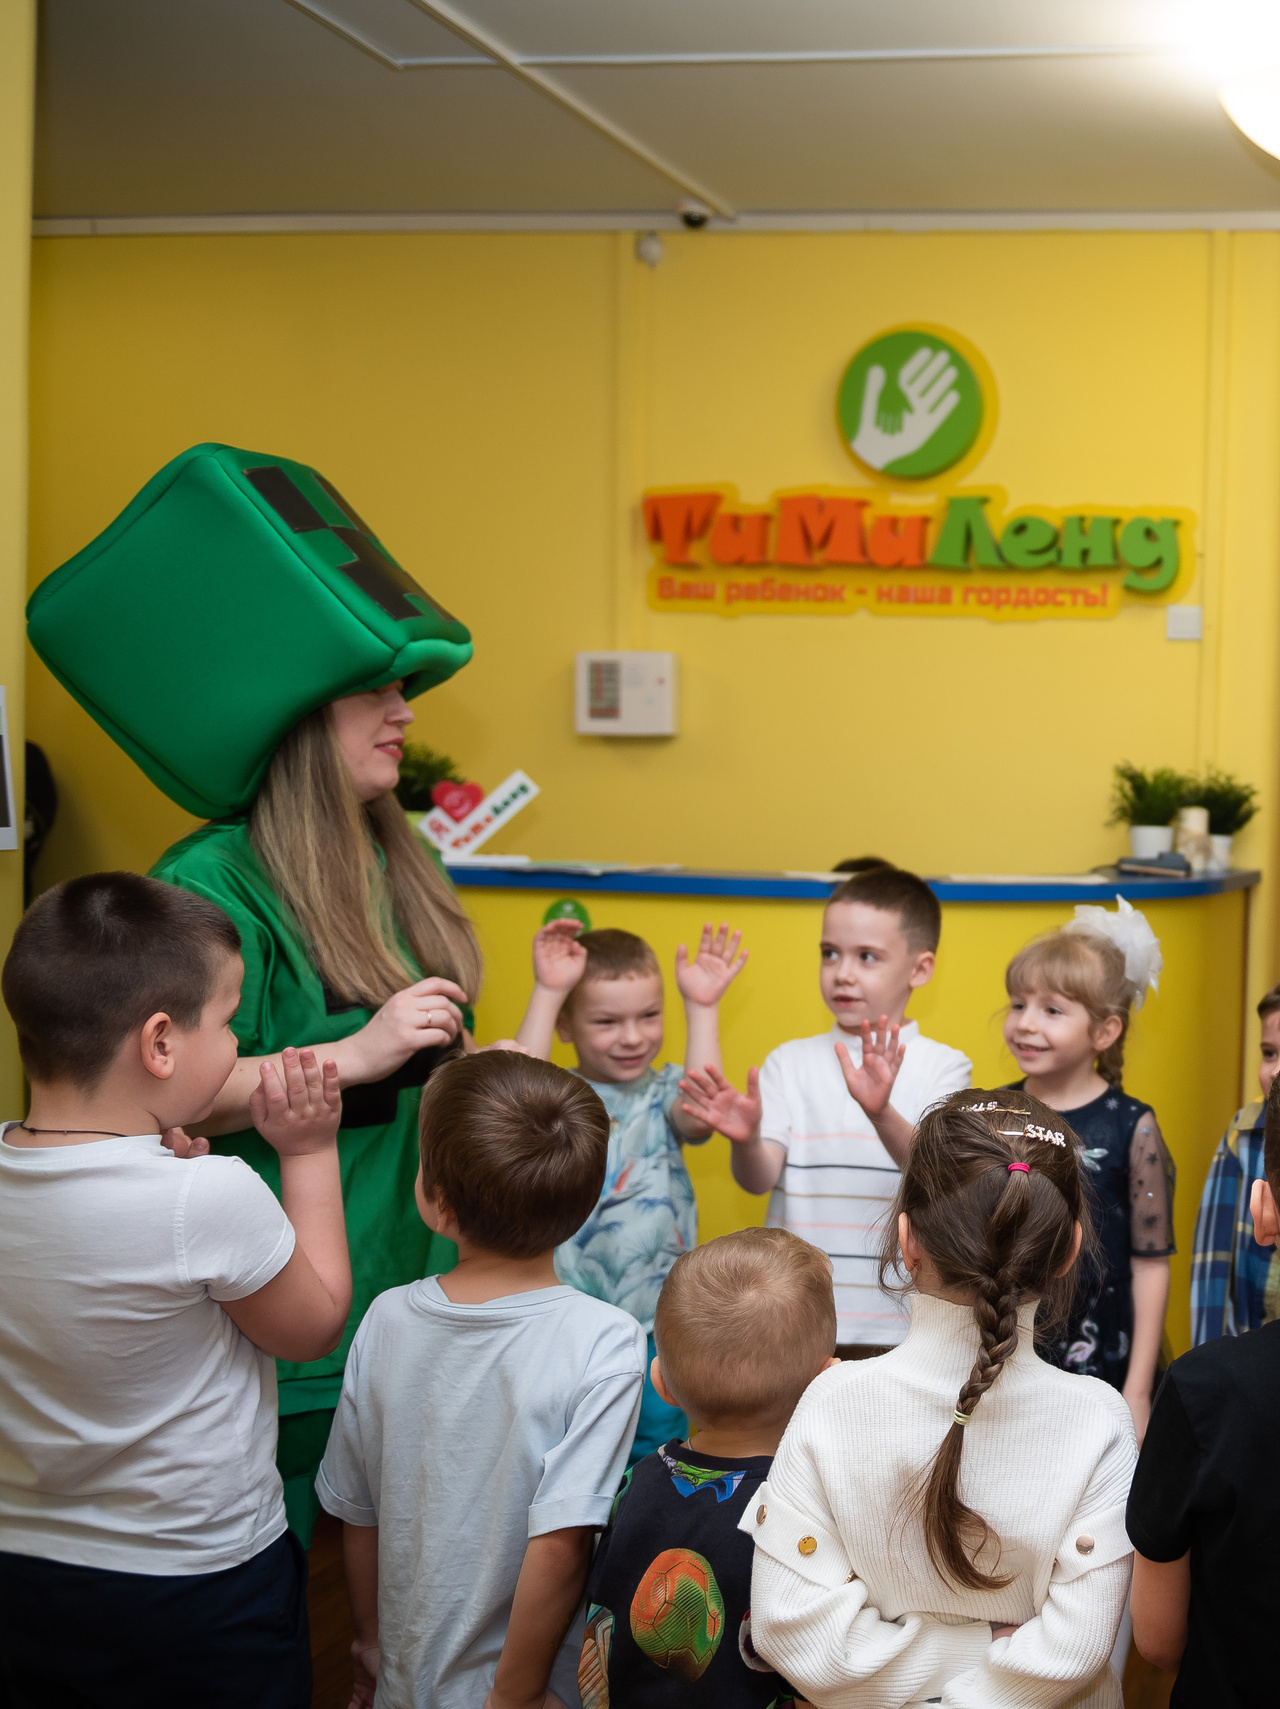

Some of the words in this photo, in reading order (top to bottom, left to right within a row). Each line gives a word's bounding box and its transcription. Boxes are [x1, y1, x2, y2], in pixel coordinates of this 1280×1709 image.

[642, 493, 1181, 593] ТиМиЛенд
[657, 576, 718, 600] Ваш
[725, 578, 848, 606] ребенок
[877, 585, 954, 604] наша
[963, 583, 1109, 609] гордость!
[1024, 1123, 1067, 1148] STAR
